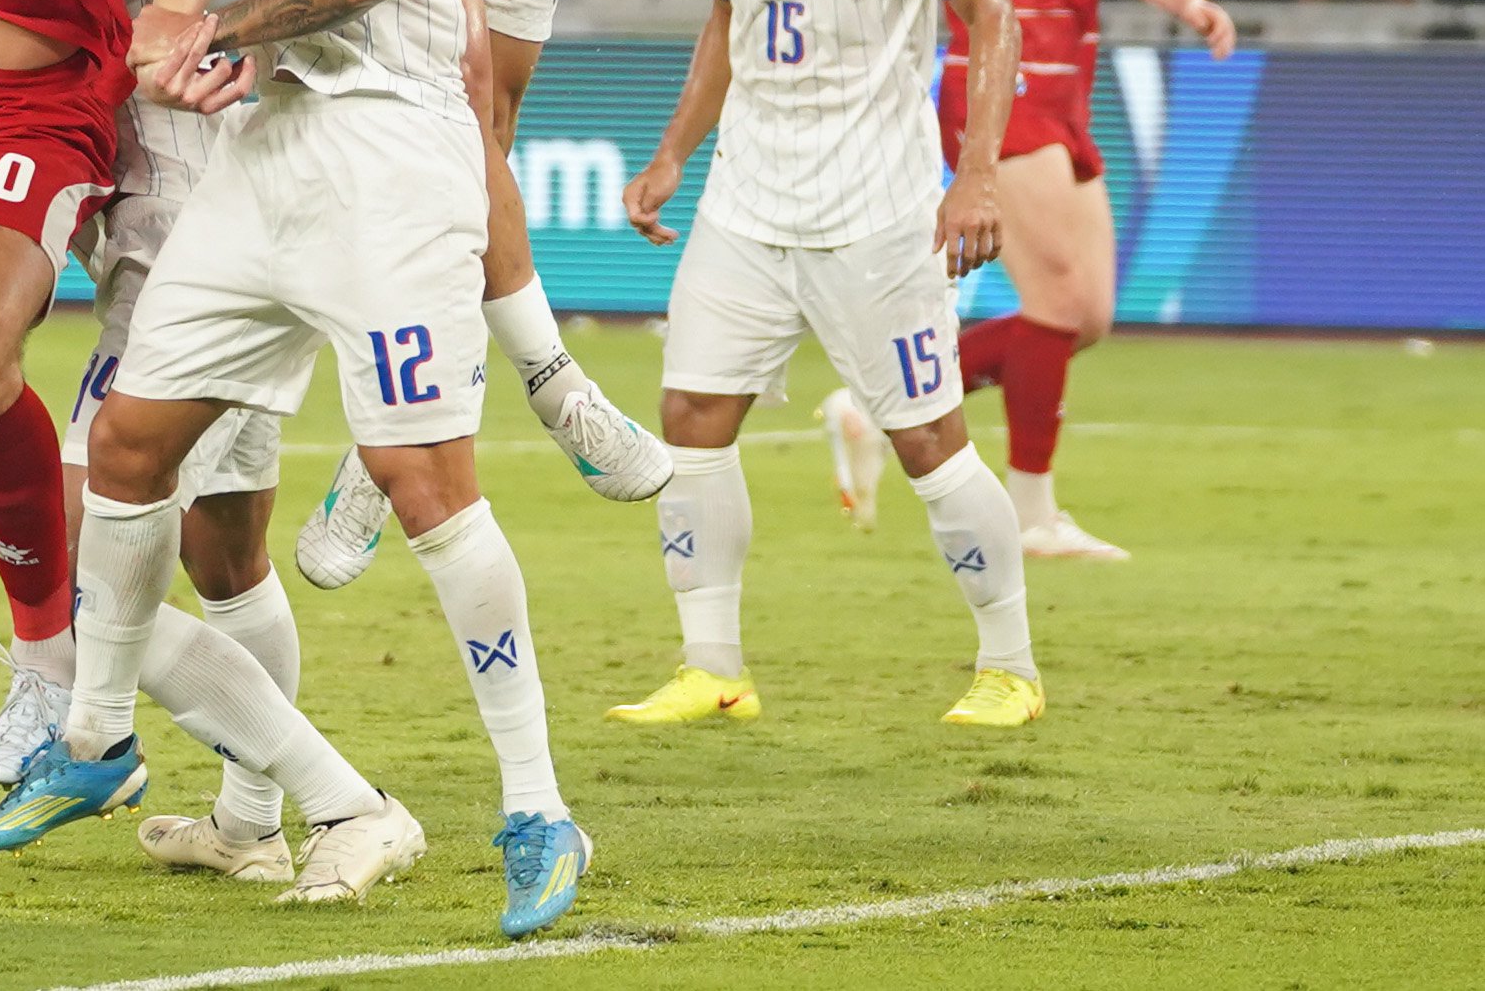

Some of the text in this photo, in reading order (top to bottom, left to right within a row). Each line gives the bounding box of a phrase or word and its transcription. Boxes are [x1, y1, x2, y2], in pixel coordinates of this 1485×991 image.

[767, 0, 805, 64] 15
[366, 324, 442, 407] 12
[891, 327, 943, 399] 15
